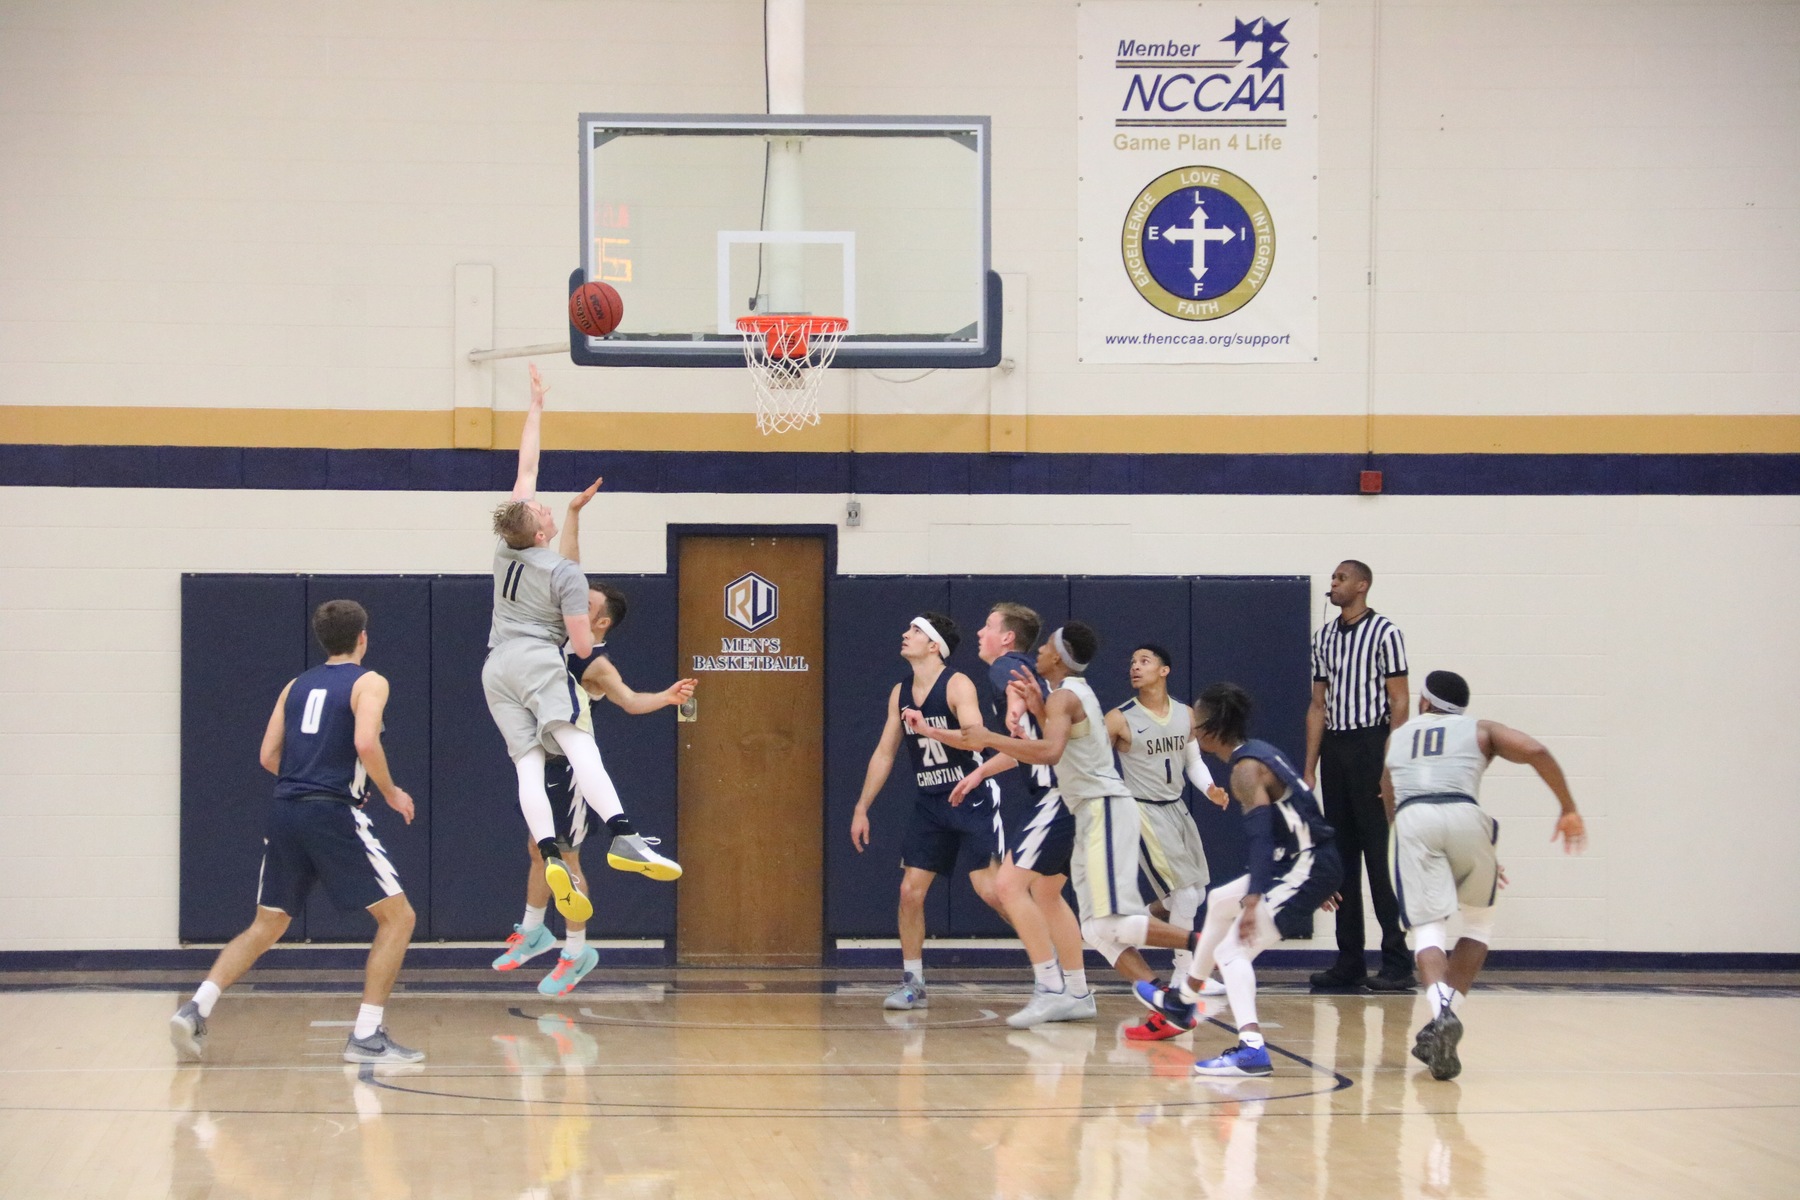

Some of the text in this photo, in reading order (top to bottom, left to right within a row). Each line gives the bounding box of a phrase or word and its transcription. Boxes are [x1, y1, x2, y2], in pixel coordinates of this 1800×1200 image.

[1117, 39, 1201, 57] Member
[1122, 73, 1286, 112] NCCAA
[1113, 133, 1283, 151] Game Plan 4 Life
[1180, 171, 1220, 186] LOVE
[1195, 190, 1205, 204] L
[1127, 192, 1156, 288] EXCELLENCE
[1148, 226, 1159, 240] E
[1247, 210, 1272, 290] INTEGRITY
[1194, 283, 1204, 297] F
[1177, 301, 1220, 315] FAITH
[1105, 332, 1291, 348] www.thenccaa.org/support
[502, 560, 525, 602] 11
[729, 577, 773, 626] RU
[721, 637, 781, 654] MEN'S
[693, 655, 809, 672] BASKETBALL
[300, 688, 328, 734] 0
[917, 737, 949, 768] 20
[1146, 734, 1186, 756] SAINTS
[1410, 726, 1447, 760] 10
[916, 765, 965, 787] CHRISTIAN
[1164, 758, 1172, 784] 1
